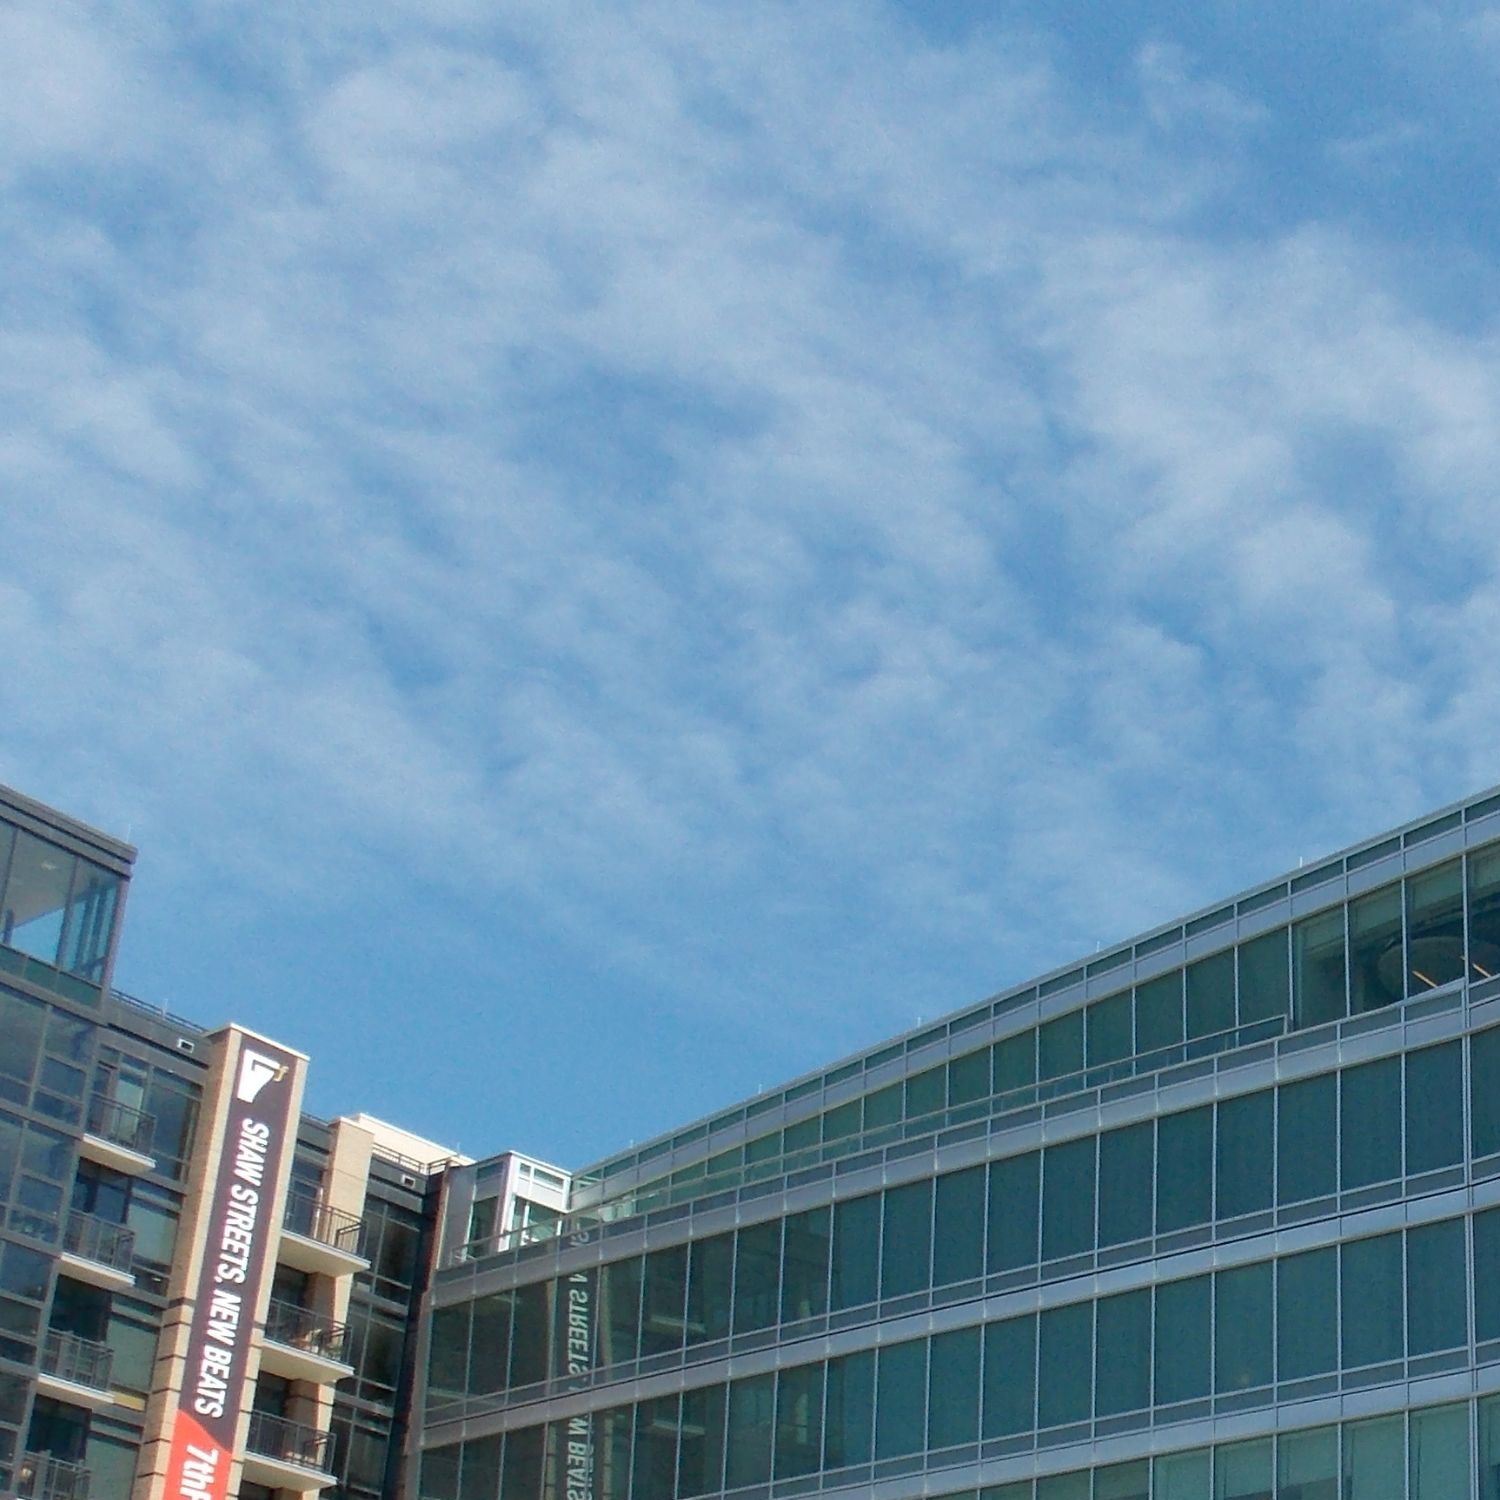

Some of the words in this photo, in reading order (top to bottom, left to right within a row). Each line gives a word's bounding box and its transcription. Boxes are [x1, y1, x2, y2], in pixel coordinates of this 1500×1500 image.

[233, 1117, 270, 1188] SHAW
[207, 1288, 242, 1346] NEW
[194, 1344, 232, 1418] BEATS
